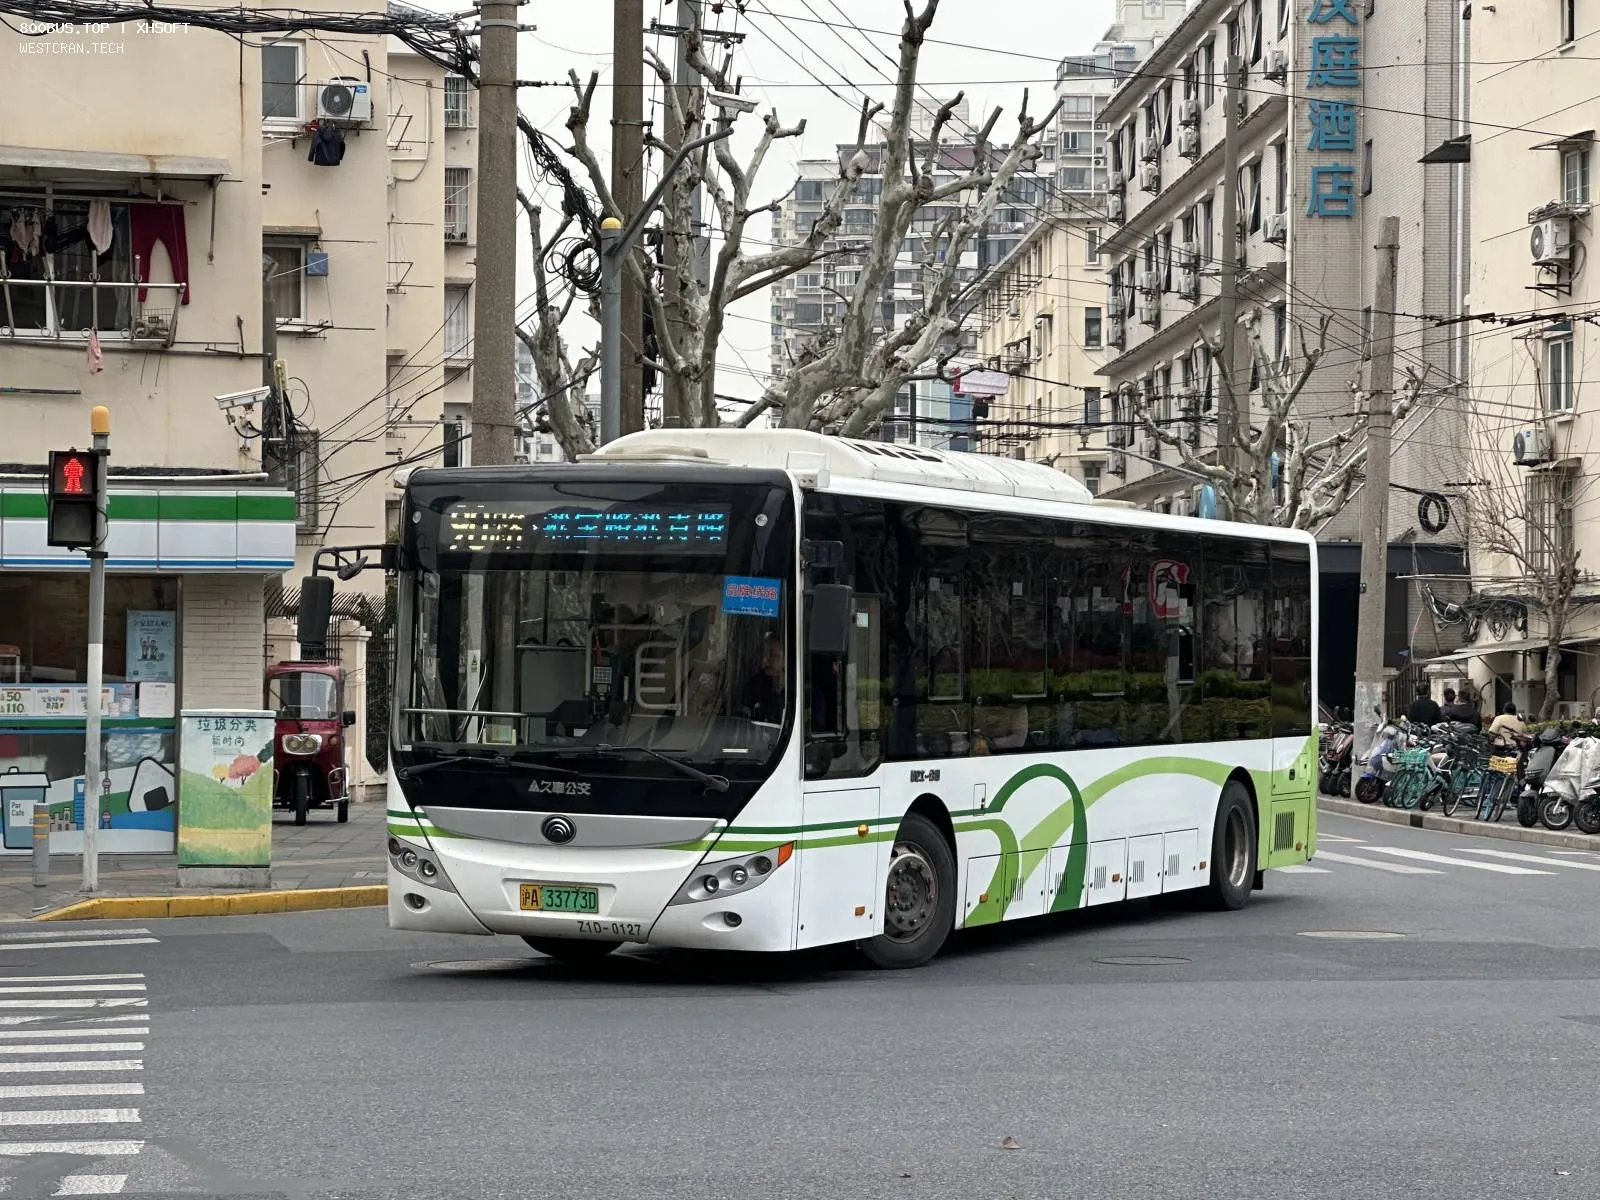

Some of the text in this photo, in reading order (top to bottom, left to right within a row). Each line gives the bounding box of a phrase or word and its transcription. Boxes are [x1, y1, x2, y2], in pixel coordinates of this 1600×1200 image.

[197, 718, 257, 732] 垃圾分类
[545, 889, 597, 910] 33773D
[577, 920, 641, 936] Z1D-0127
